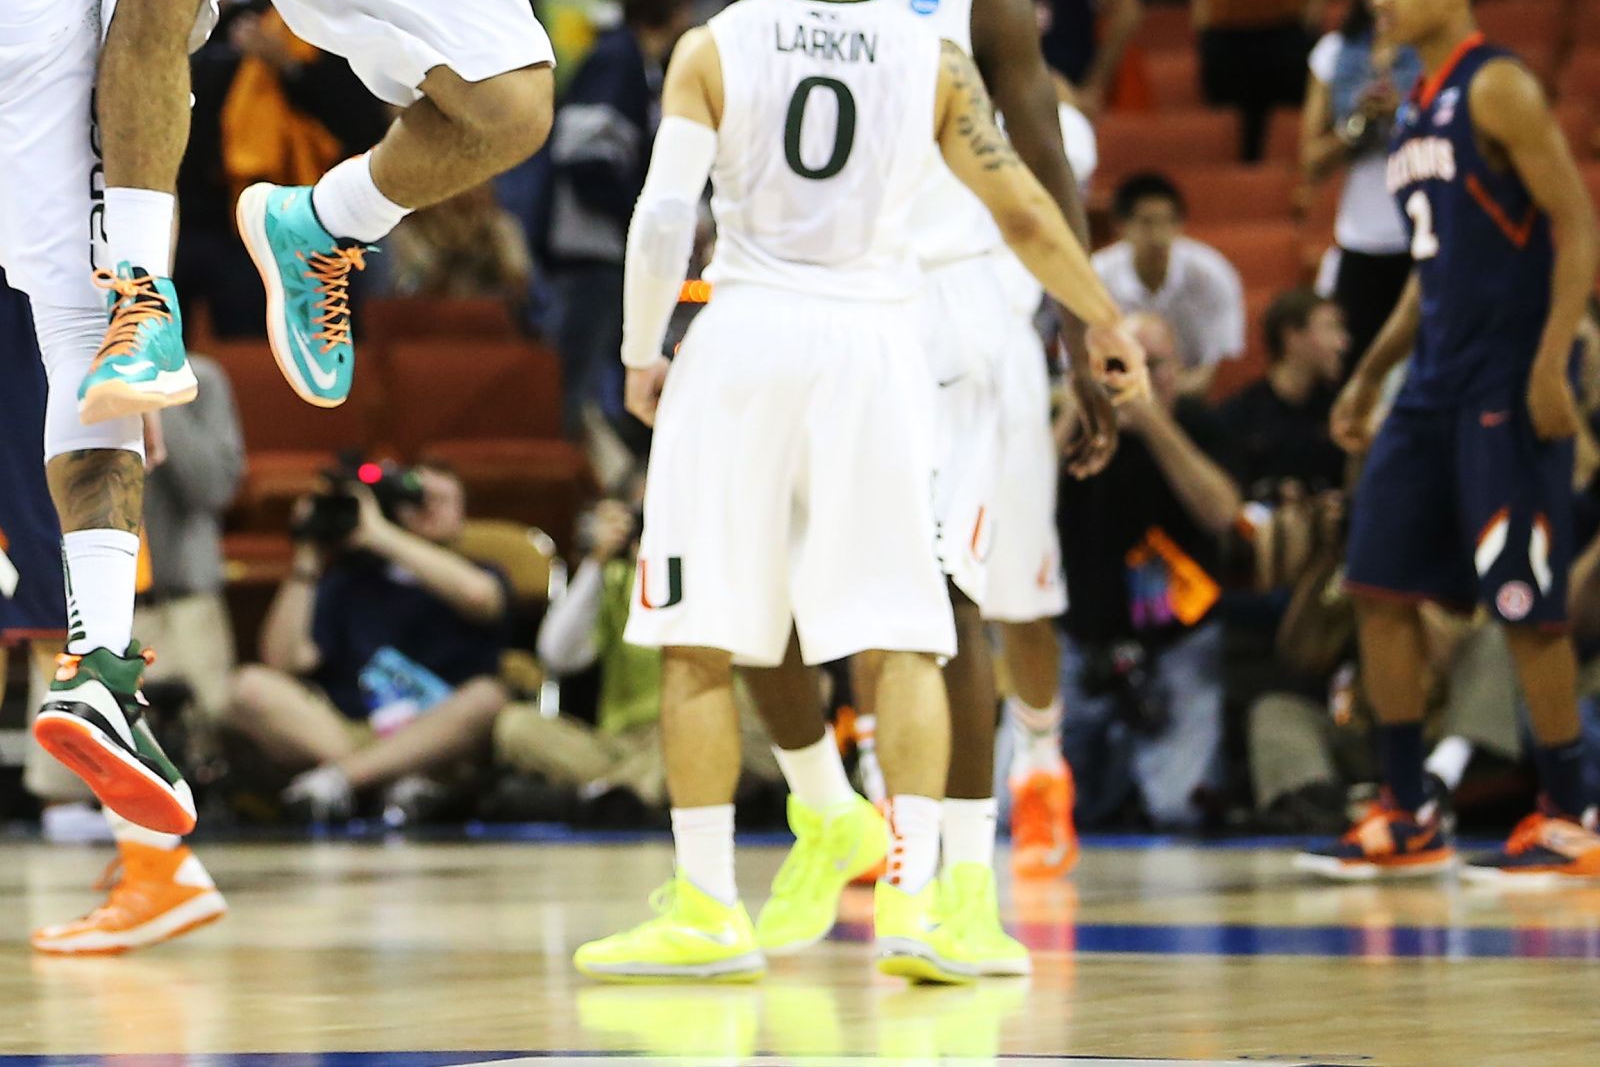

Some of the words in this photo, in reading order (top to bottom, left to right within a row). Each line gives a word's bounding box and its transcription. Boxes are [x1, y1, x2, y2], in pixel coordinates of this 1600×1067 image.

[774, 20, 878, 64] LARKIN
[784, 76, 856, 180] 0
[640, 556, 683, 609] U
